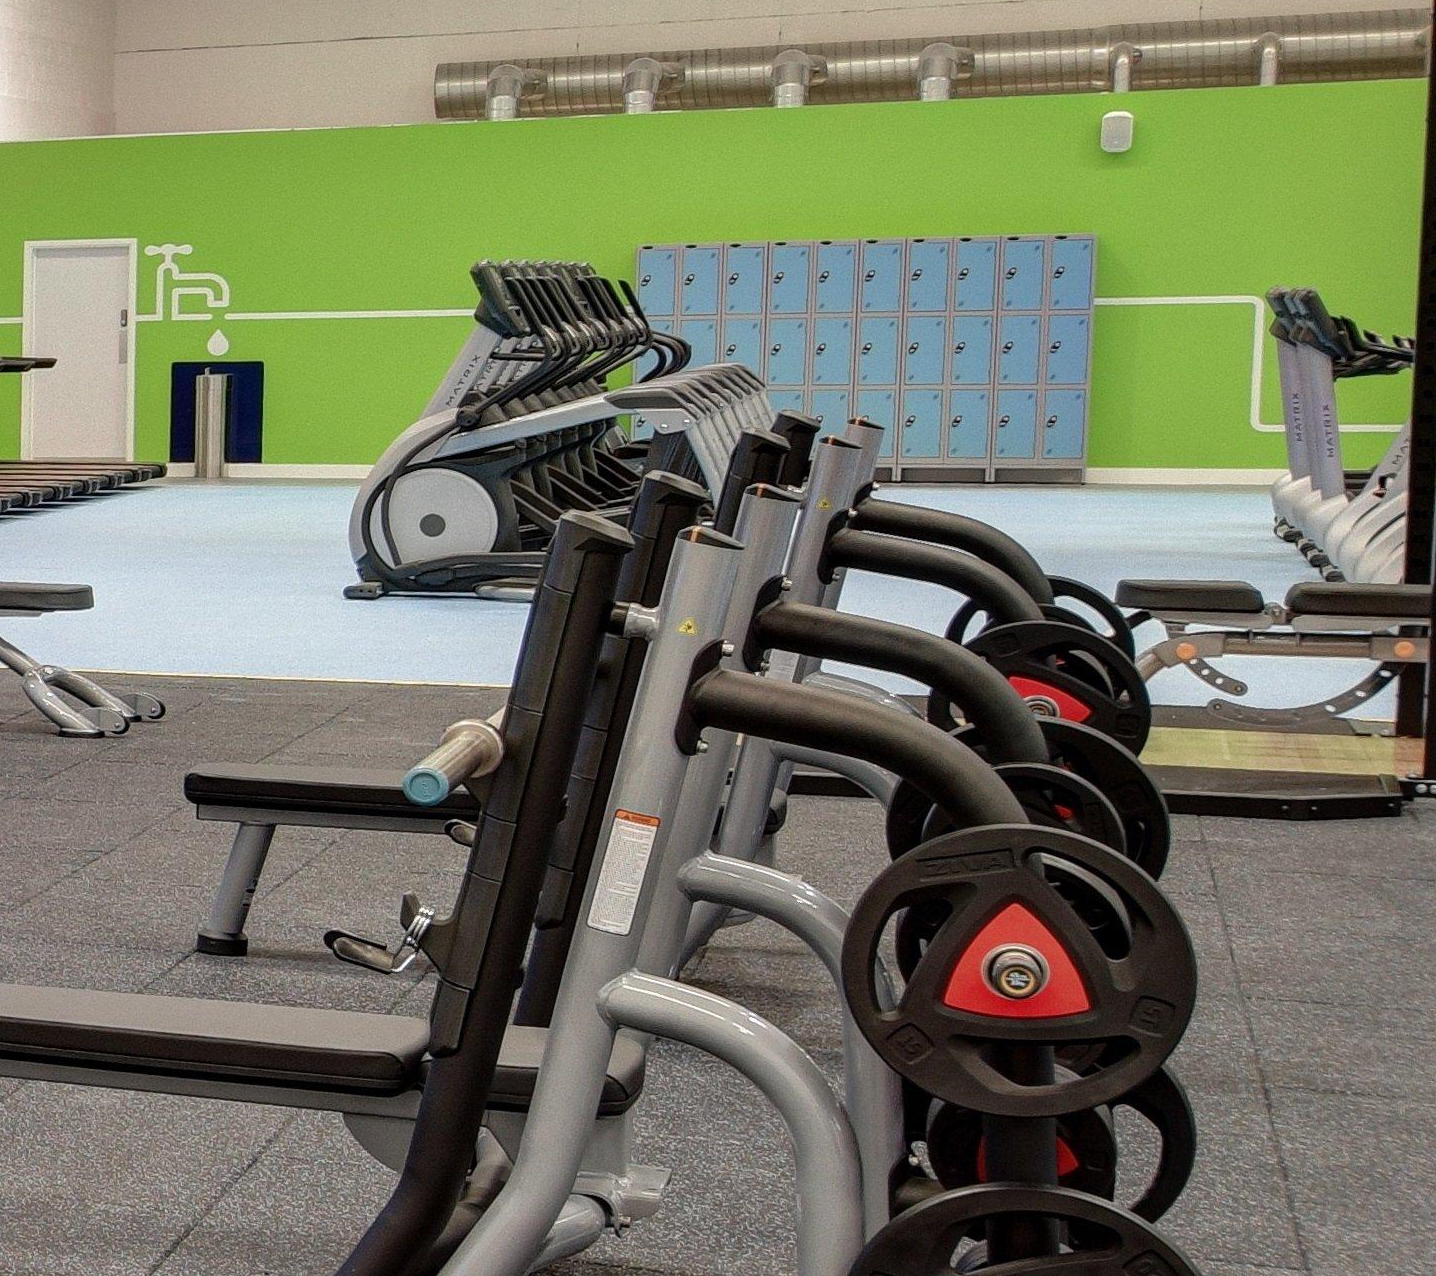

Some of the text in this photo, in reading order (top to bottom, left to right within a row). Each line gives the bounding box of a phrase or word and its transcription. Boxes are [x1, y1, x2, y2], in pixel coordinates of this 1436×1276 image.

[445, 355, 480, 407] MATRIX
[1292, 392, 1303, 443] MATRIX
[1323, 404, 1334, 459] MATRIX
[921, 853, 1010, 878] ZIVA
